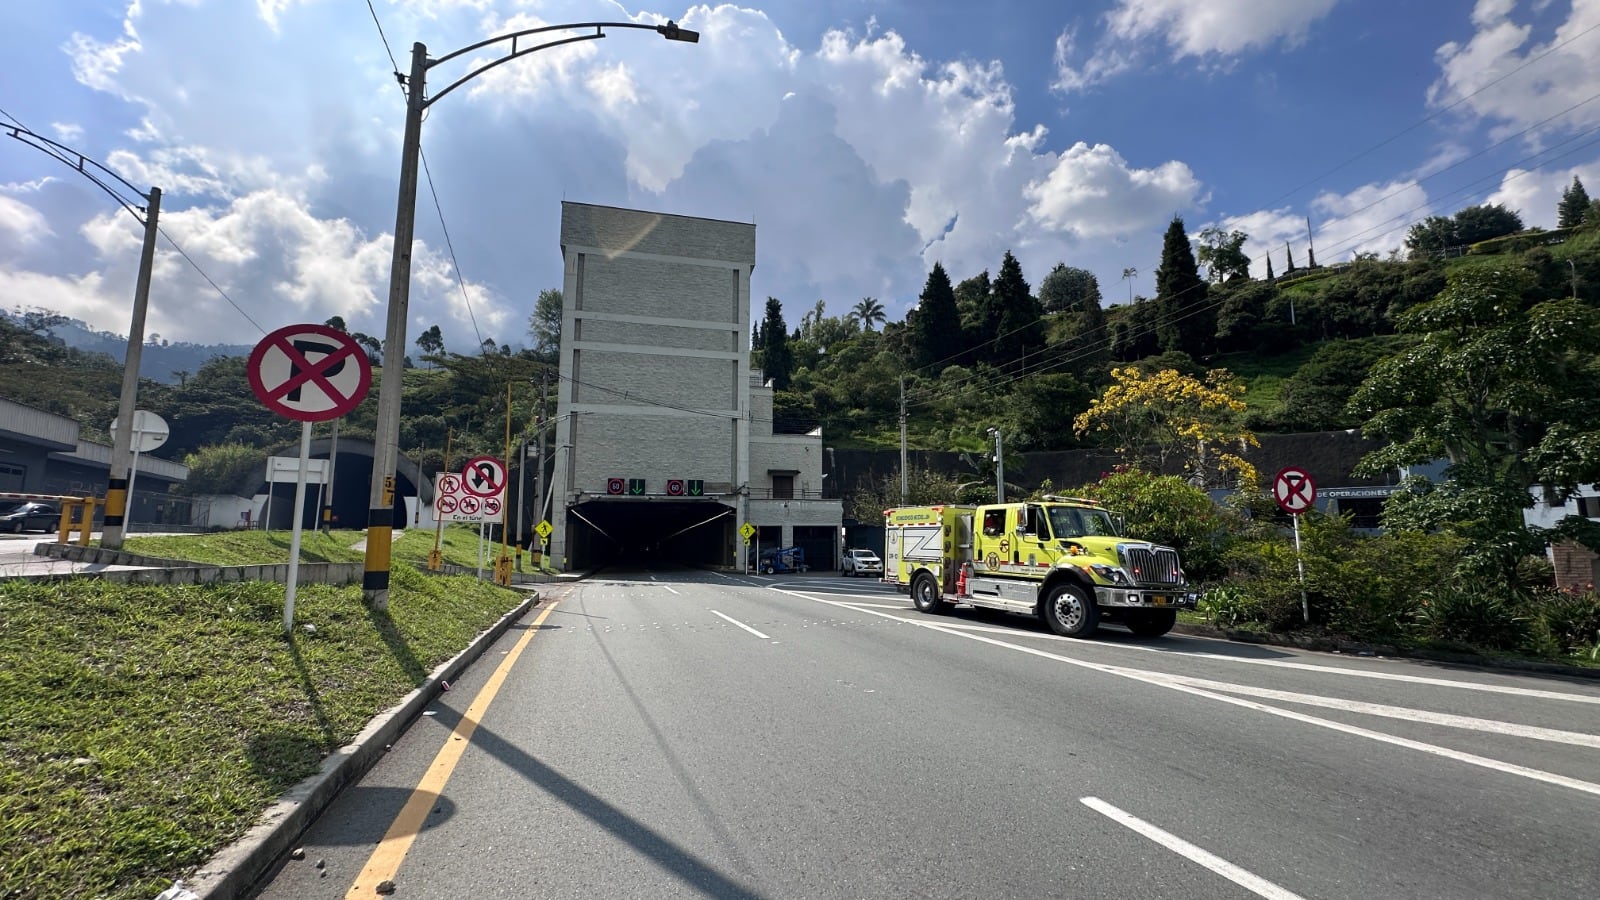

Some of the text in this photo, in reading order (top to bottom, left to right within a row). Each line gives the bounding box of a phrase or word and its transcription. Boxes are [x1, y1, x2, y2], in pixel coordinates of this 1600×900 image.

[287, 339, 346, 402] P
[1287, 474, 1306, 506] P
[1329, 489, 1387, 498] OPERACIONES
